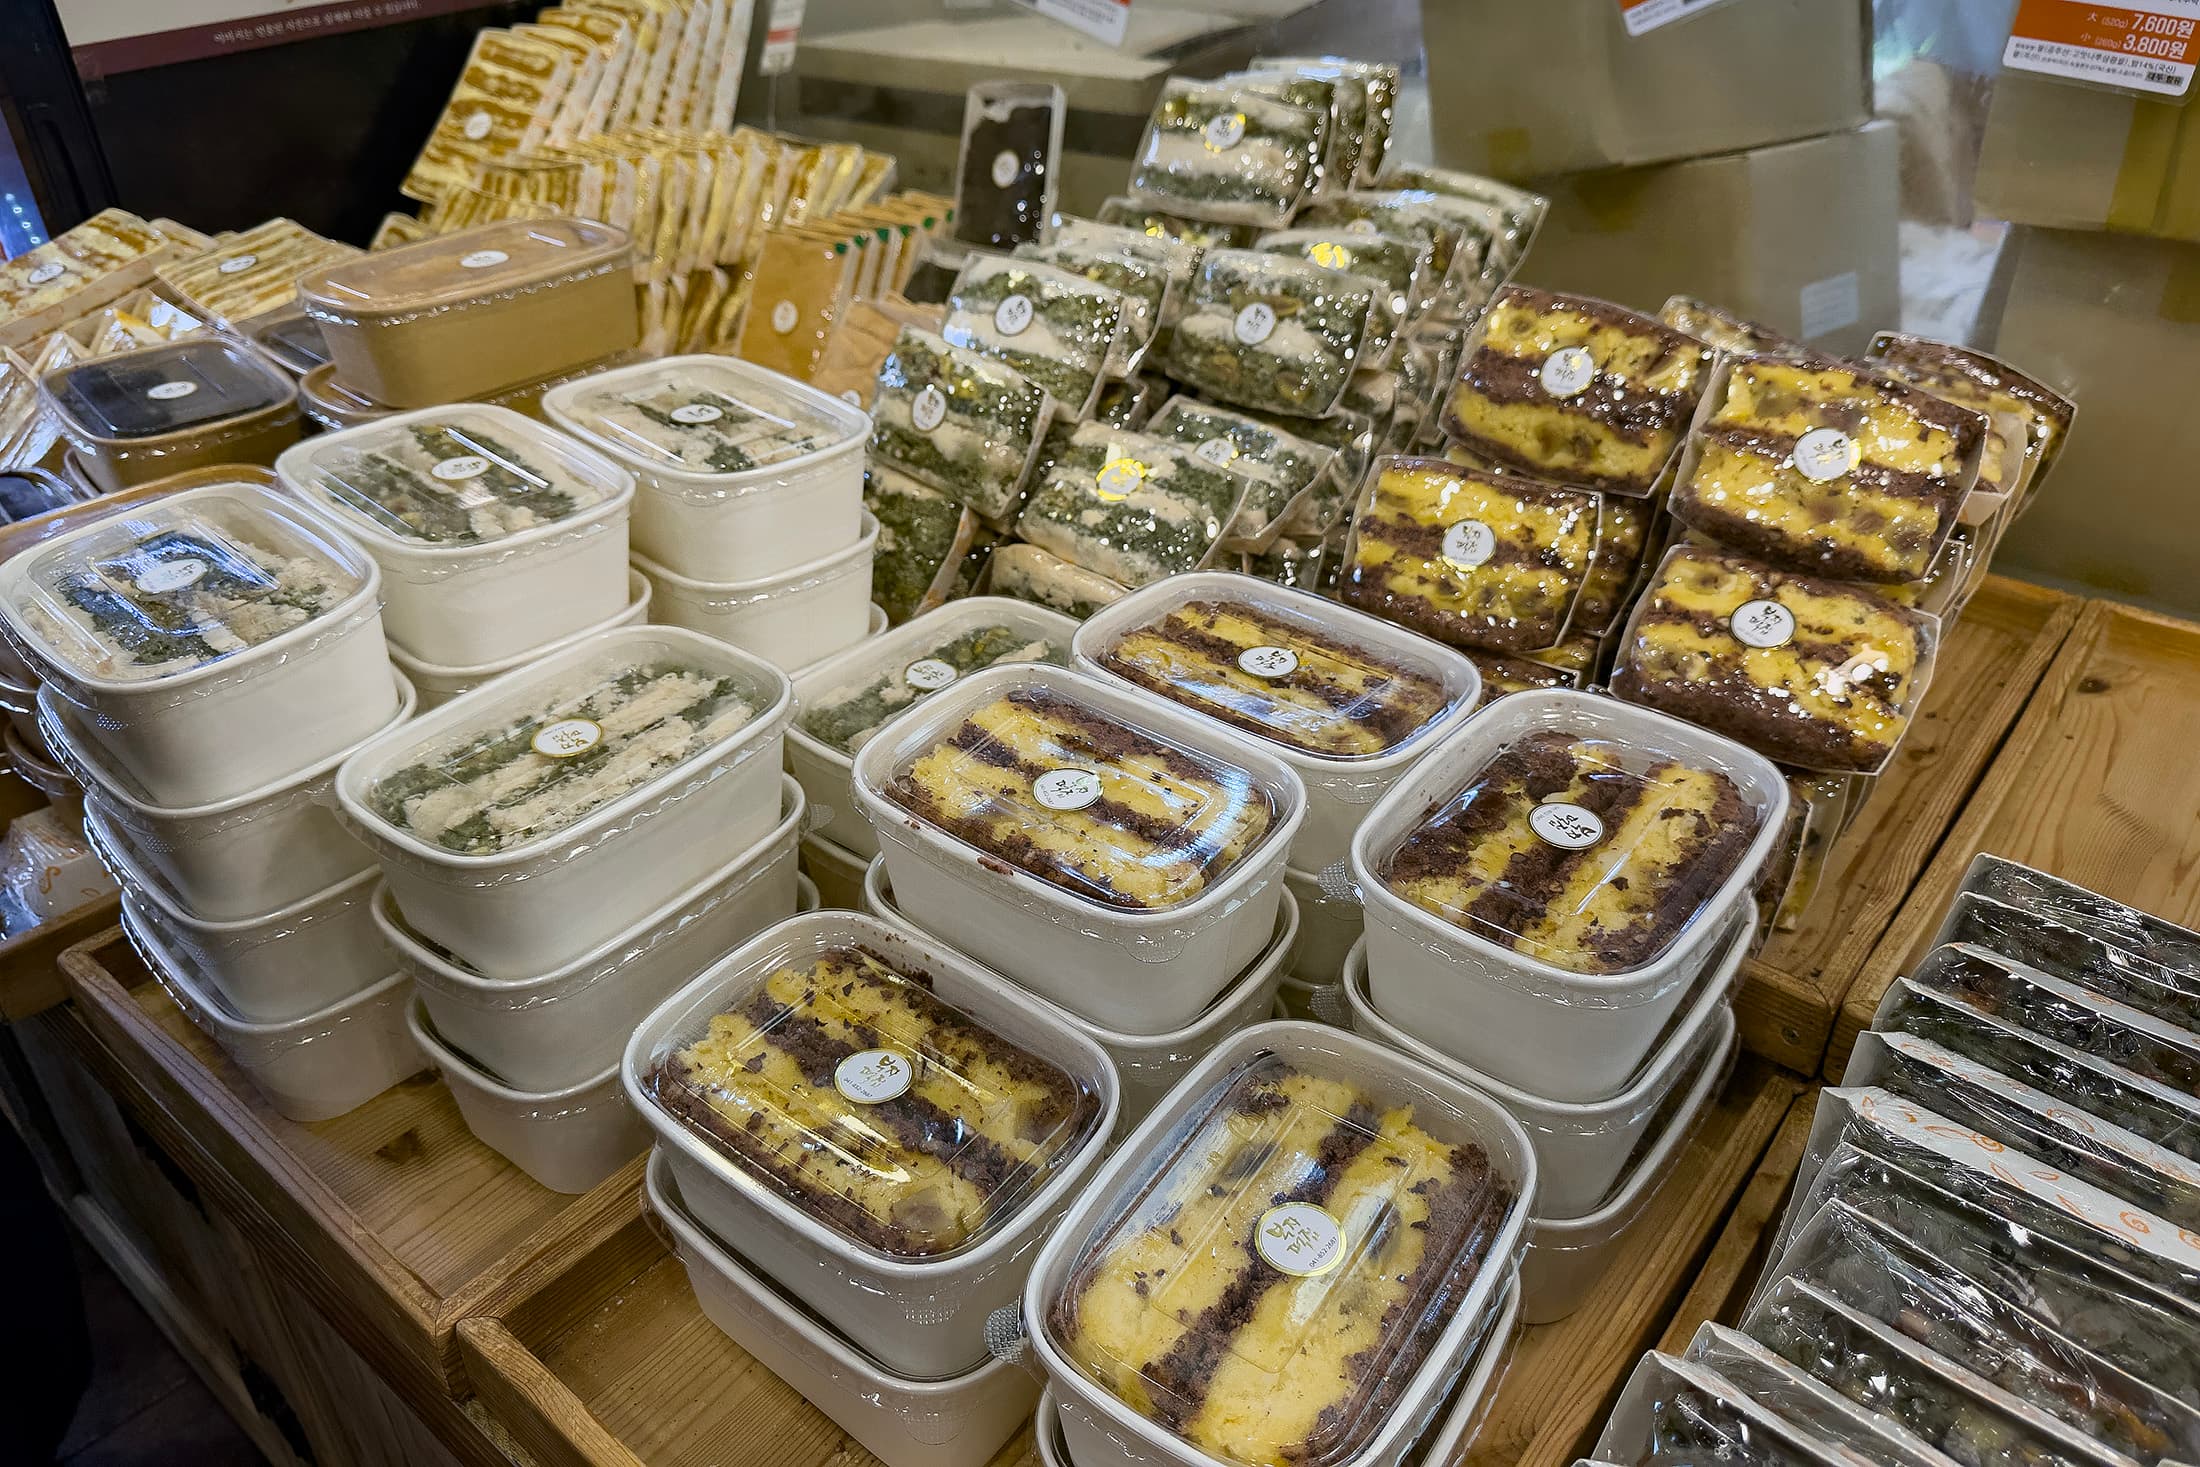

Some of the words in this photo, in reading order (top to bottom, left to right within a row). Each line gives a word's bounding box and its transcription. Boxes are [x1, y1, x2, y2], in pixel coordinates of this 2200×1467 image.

[2131, 13, 2195, 39] 7,600원
[2122, 34, 2187, 60] 3,800원
[1266, 1216, 1300, 1240] 부자
